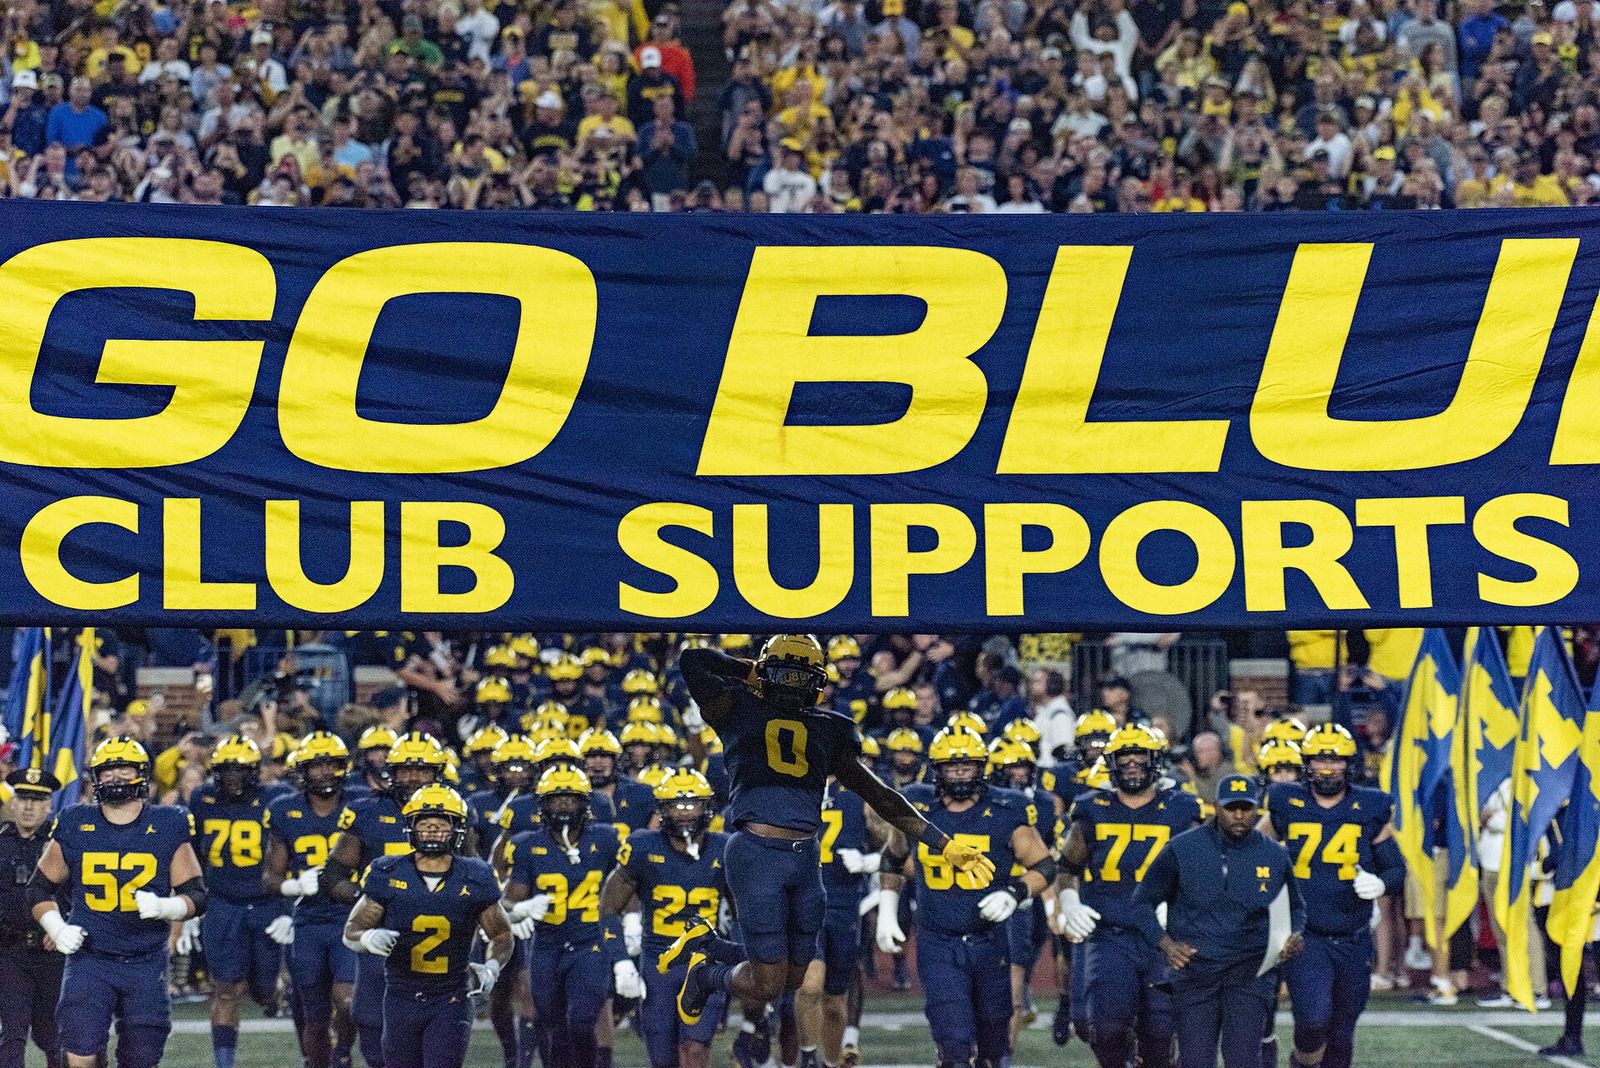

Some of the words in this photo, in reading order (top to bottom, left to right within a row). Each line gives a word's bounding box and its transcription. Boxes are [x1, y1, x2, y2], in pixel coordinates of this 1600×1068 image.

[0, 237, 598, 474] GO
[696, 238, 1600, 476] BLU
[20, 495, 516, 614] CLUB
[617, 493, 1580, 619] SUPPORTS
[765, 718, 809, 778] 0
[203, 819, 263, 867] 78
[1095, 823, 1171, 882] 77
[1287, 822, 1362, 881] 74
[81, 851, 158, 912] 52
[536, 870, 603, 925] 34
[652, 884, 720, 937] 23
[411, 914, 452, 974] 2
